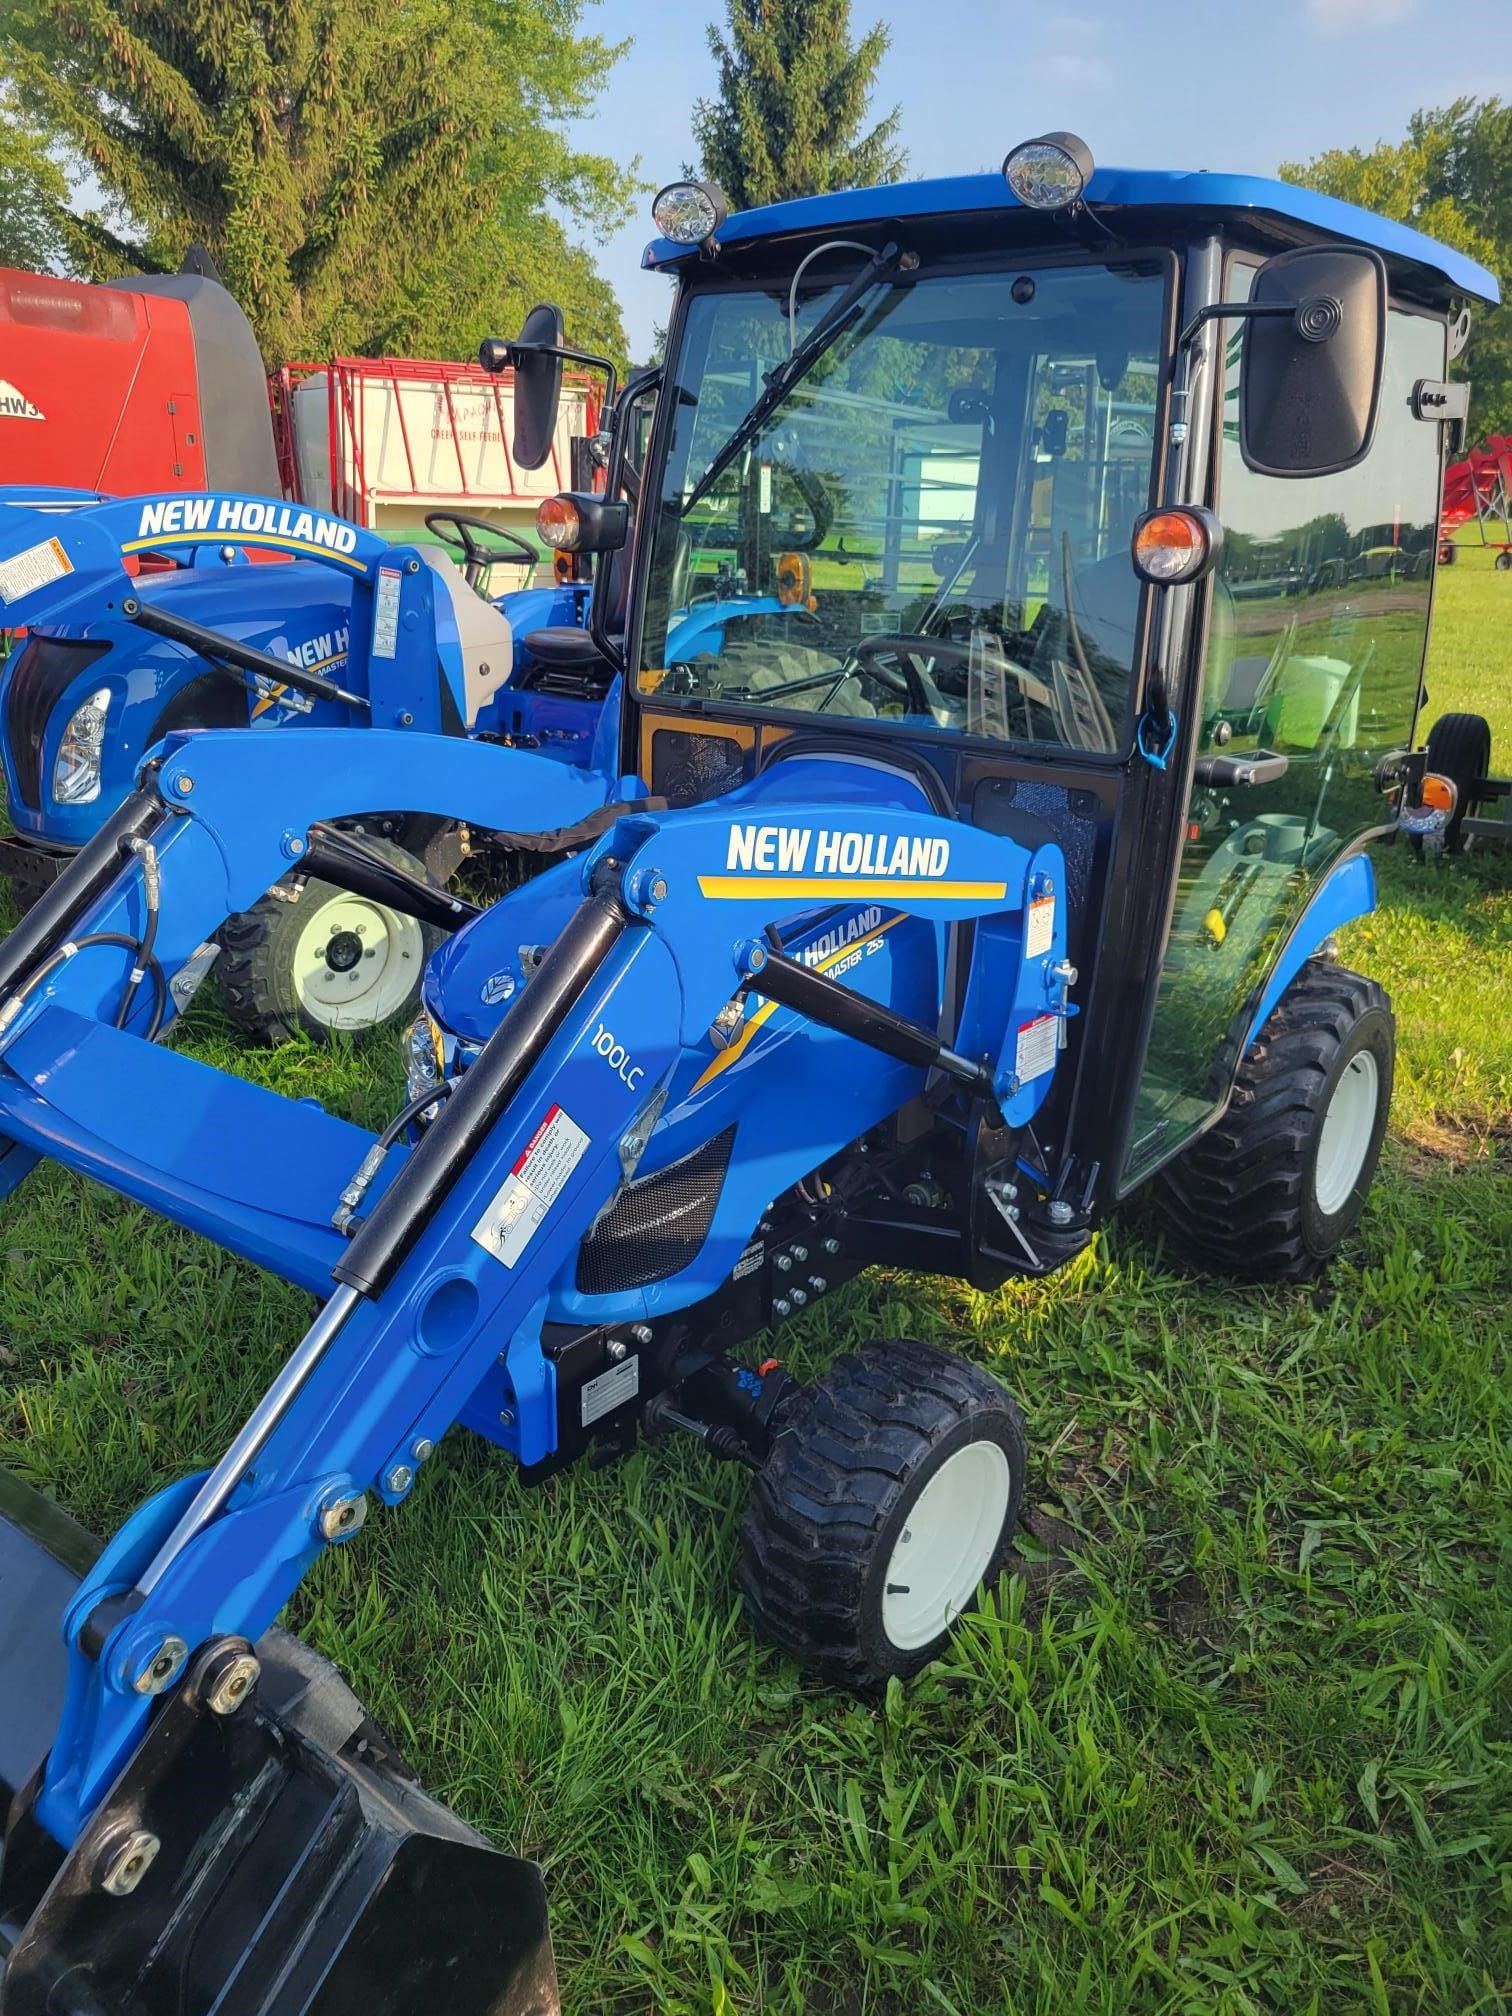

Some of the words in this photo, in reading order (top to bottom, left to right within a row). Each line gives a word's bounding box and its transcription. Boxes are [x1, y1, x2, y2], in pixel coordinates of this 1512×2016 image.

[138, 499, 215, 537] NEW
[217, 501, 357, 554] HOLLAND
[287, 632, 333, 669] NEW
[726, 824, 812, 873] NEW
[814, 830, 950, 877] HOLLAND
[804, 906, 881, 968] HOLLAND
[823, 949, 863, 980] MASTER
[592, 1023, 644, 1091] 100LC
[520, 1156, 535, 1178] Failure
[540, 1124, 556, 1148] comply
[525, 1163, 538, 1182] result
[542, 1137, 554, 1155] death
[530, 1122, 547, 1149] DANGER
[529, 1162, 546, 1187] serious
